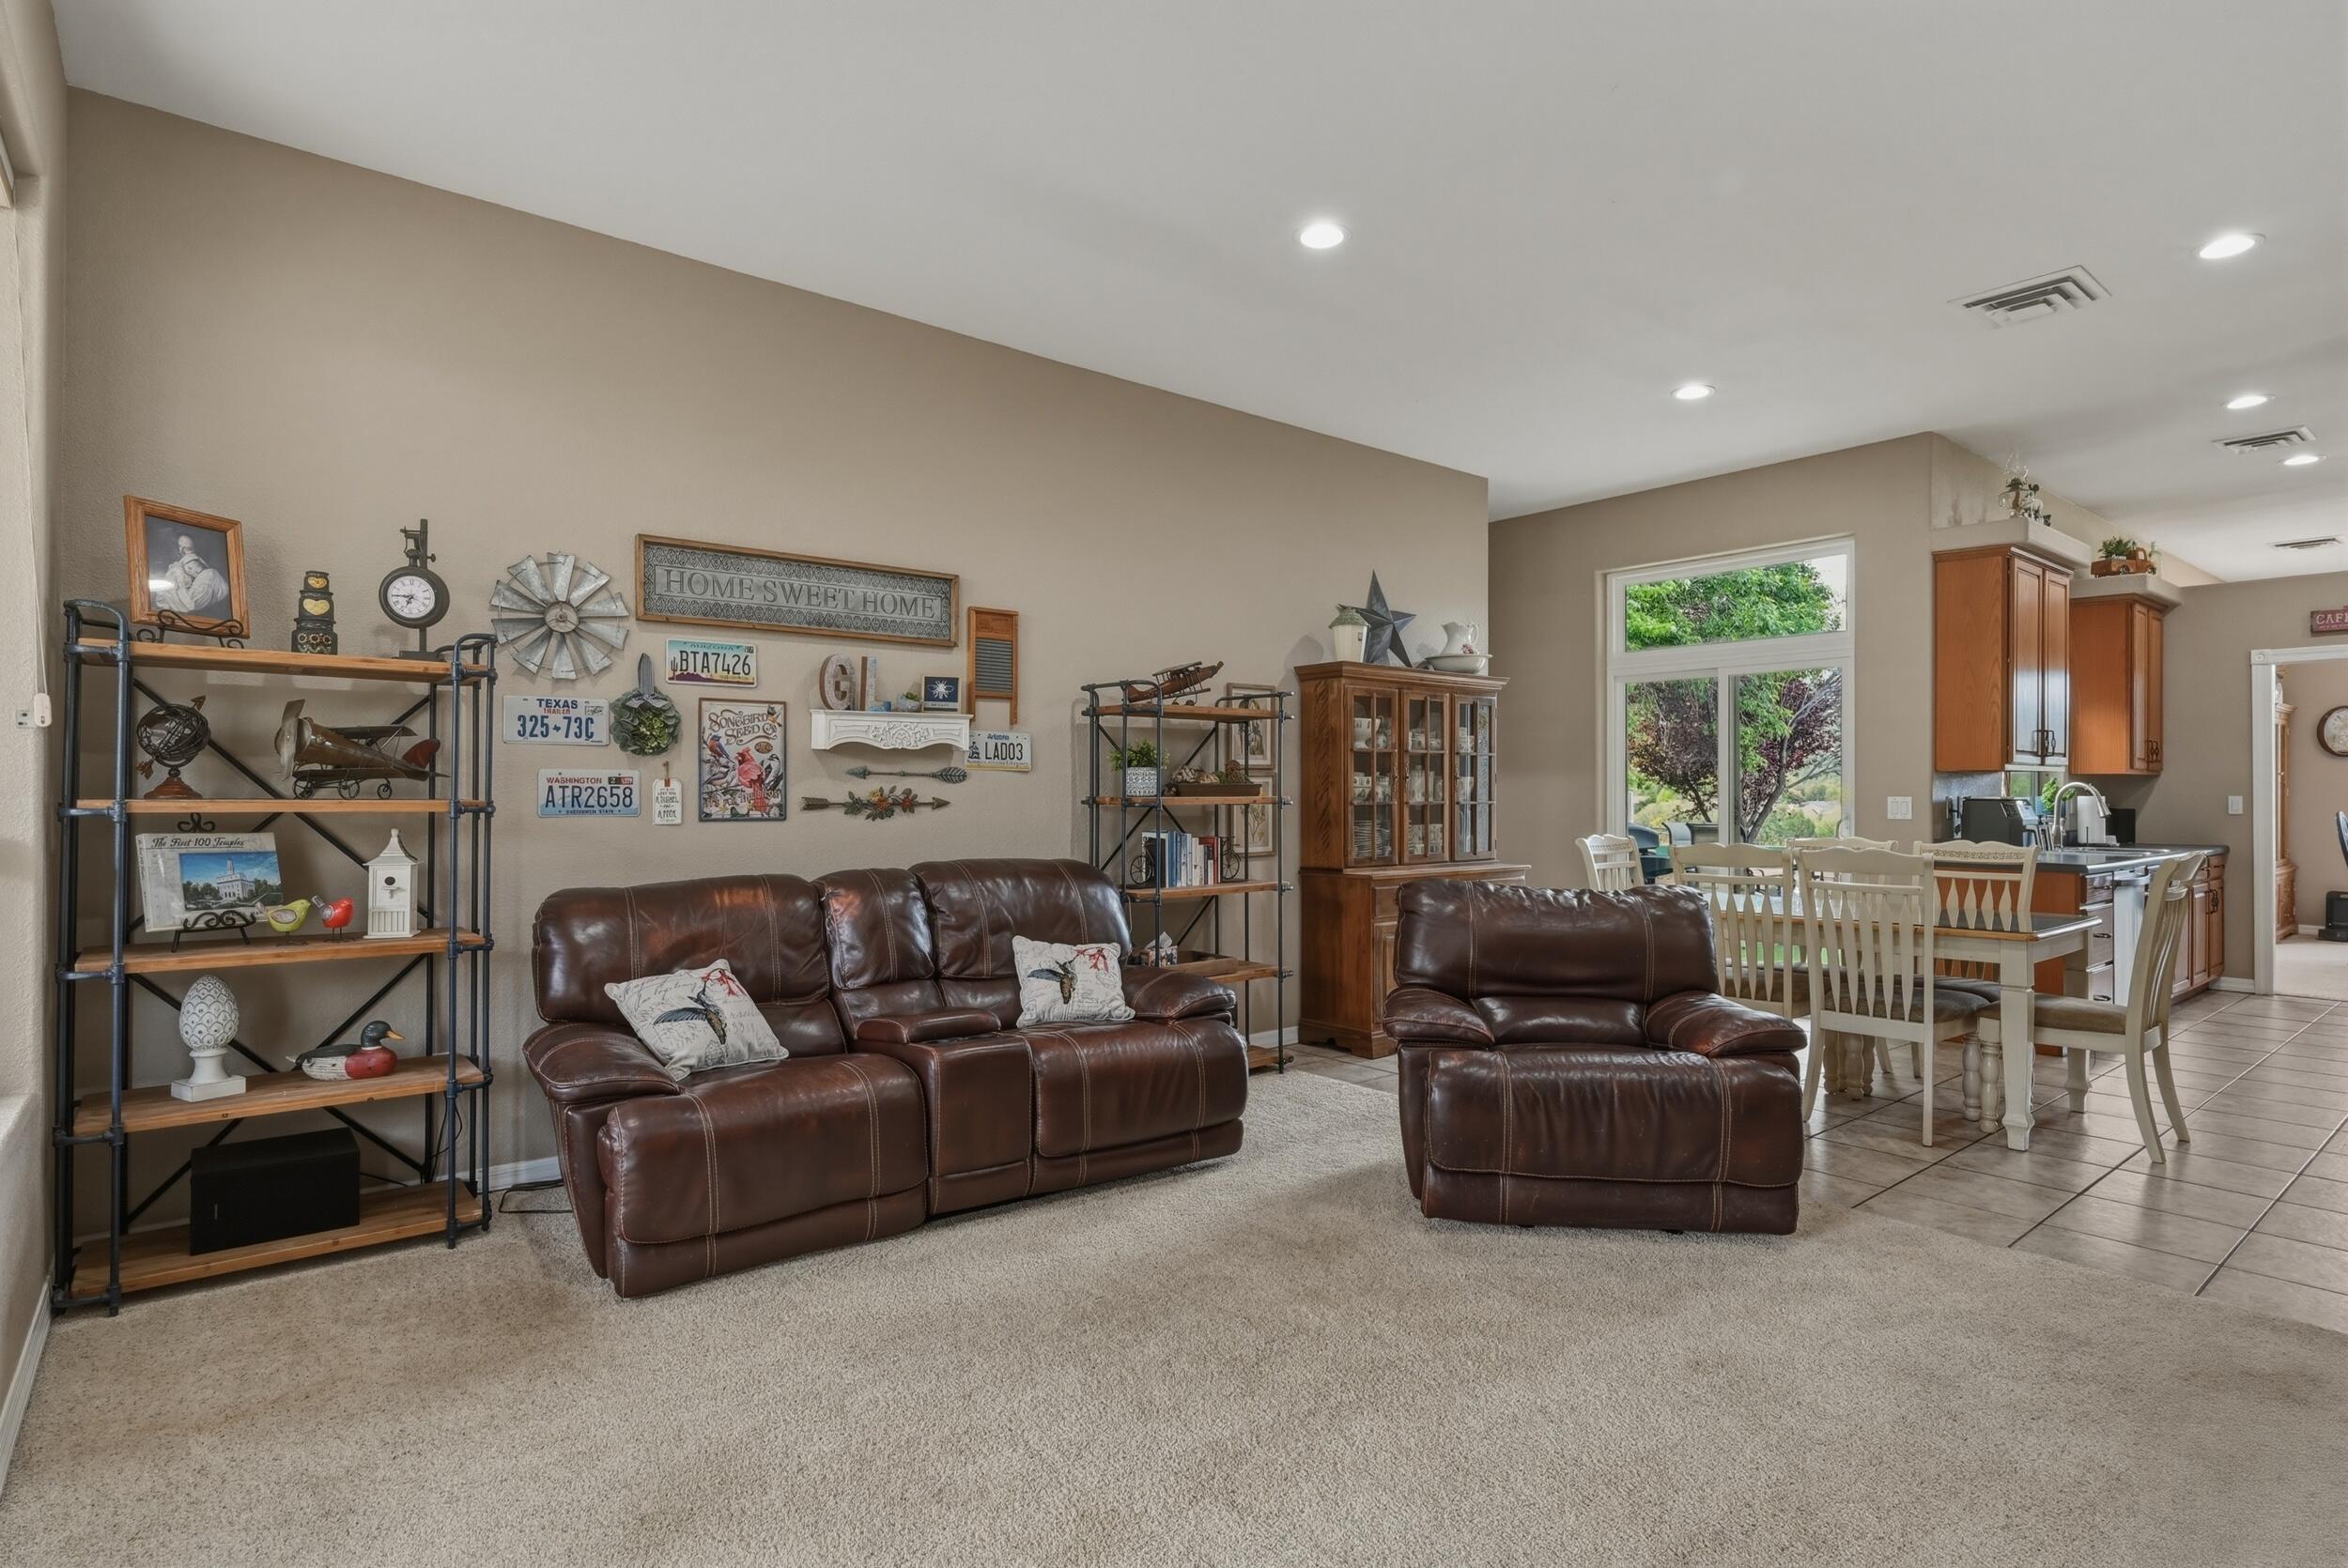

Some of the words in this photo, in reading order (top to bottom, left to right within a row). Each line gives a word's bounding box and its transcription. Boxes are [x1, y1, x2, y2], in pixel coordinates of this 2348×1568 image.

[664, 569, 754, 600] HOME
[763, 580, 856, 609] SWEET
[863, 592, 937, 619] HOME
[679, 651, 750, 675] BTA7426
[820, 654, 856, 711] G
[536, 699, 579, 709] TEXAS
[725, 723, 761, 746] SEED
[545, 785, 634, 808] ATR2658
[151, 836, 167, 847] The
[193, 838, 211, 847] 100
